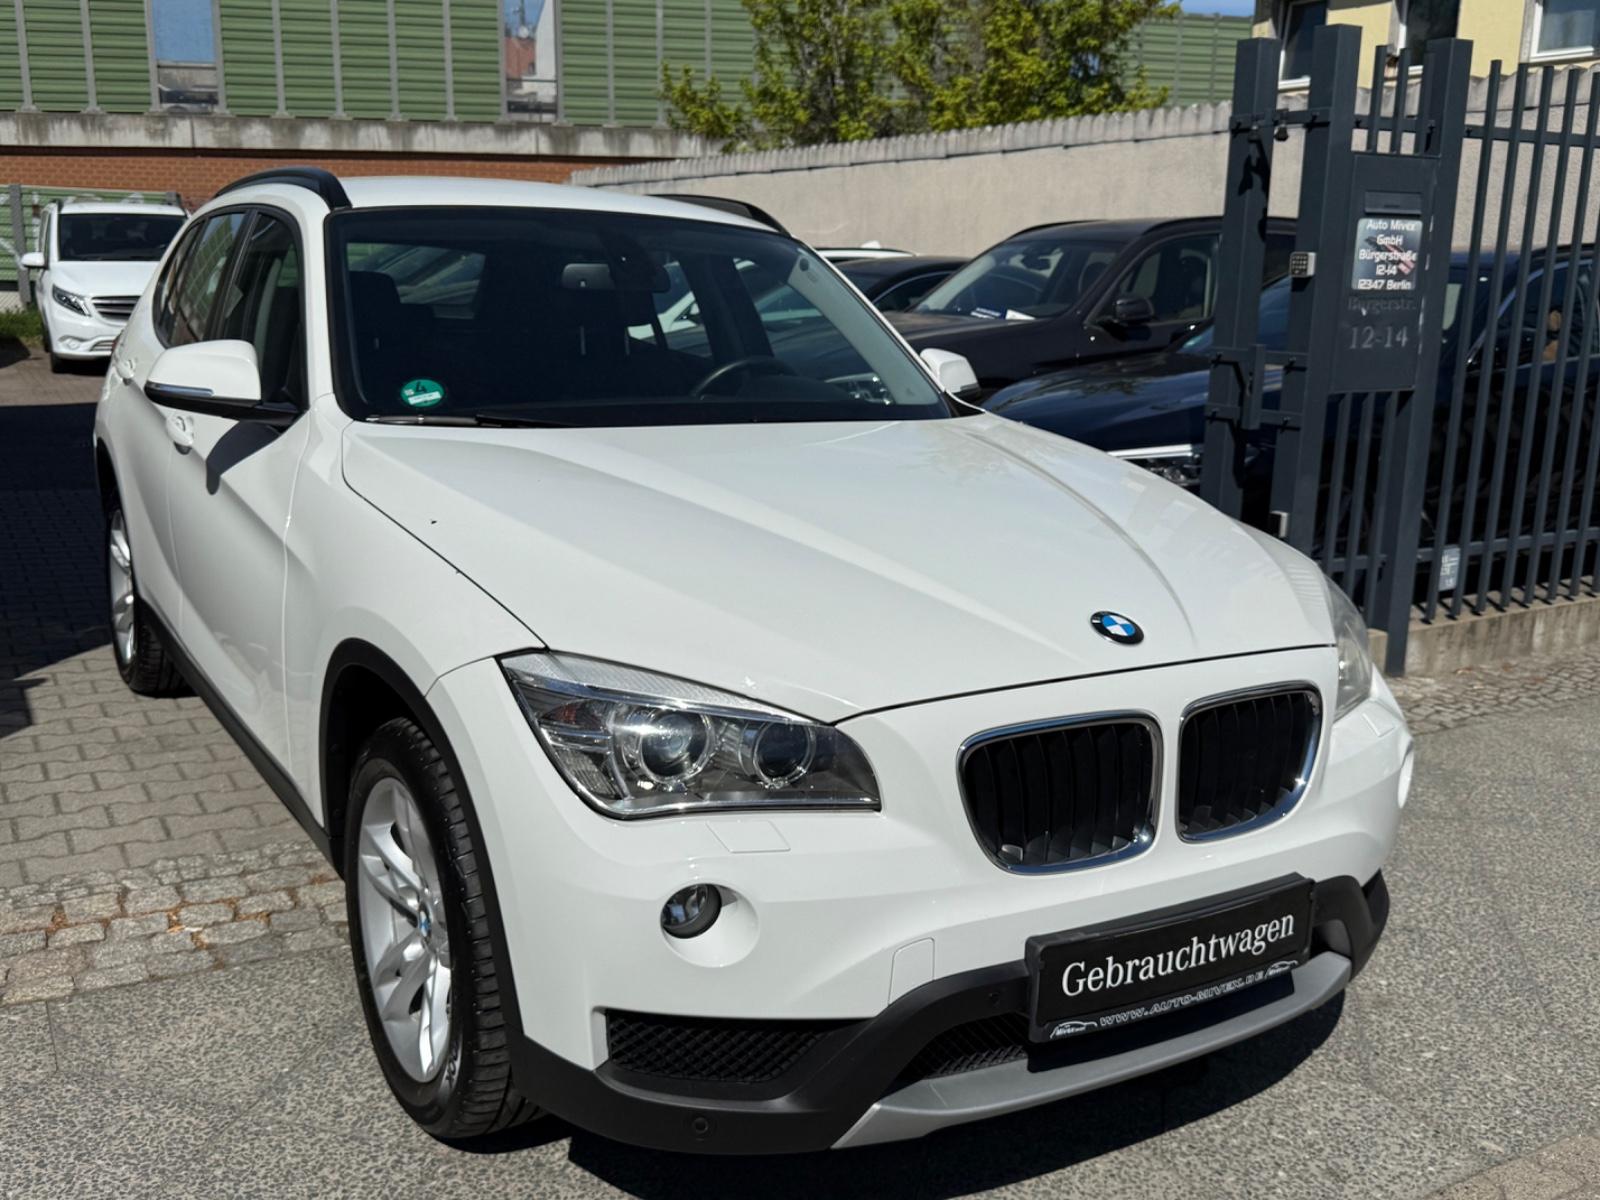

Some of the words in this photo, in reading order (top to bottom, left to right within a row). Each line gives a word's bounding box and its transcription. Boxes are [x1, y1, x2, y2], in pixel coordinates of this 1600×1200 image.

[1366, 219, 1389, 231] Auto
[1376, 234, 1404, 246] GmbH
[1375, 264, 1398, 276] 12-14
[1358, 279, 1386, 290] 12347
[1386, 279, 1412, 290] Berlin
[1349, 325, 1408, 350] 12-14
[1061, 913, 1295, 998] Gebrauchtwagen
